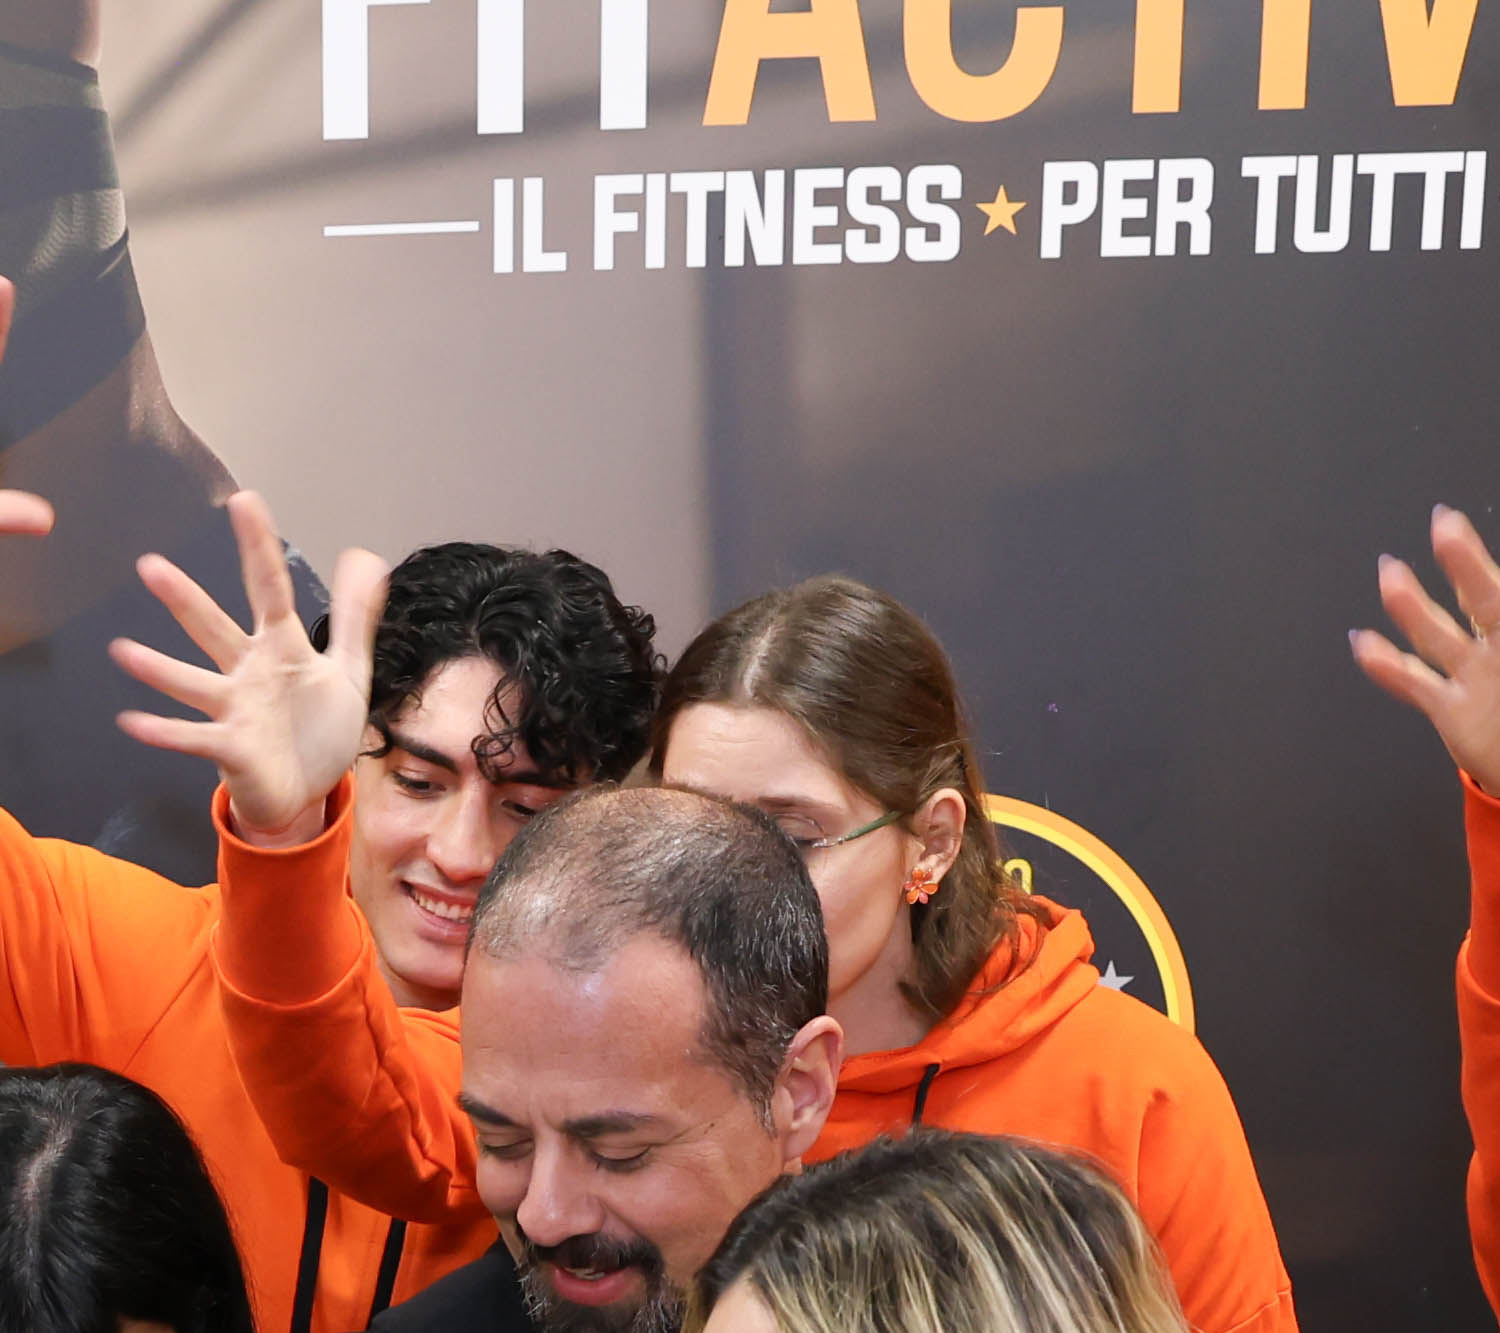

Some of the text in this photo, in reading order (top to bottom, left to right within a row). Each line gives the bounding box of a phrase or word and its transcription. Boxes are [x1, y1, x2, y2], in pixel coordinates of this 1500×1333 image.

[490, 150, 1489, 275] IL FITNESS PER TUTTI
